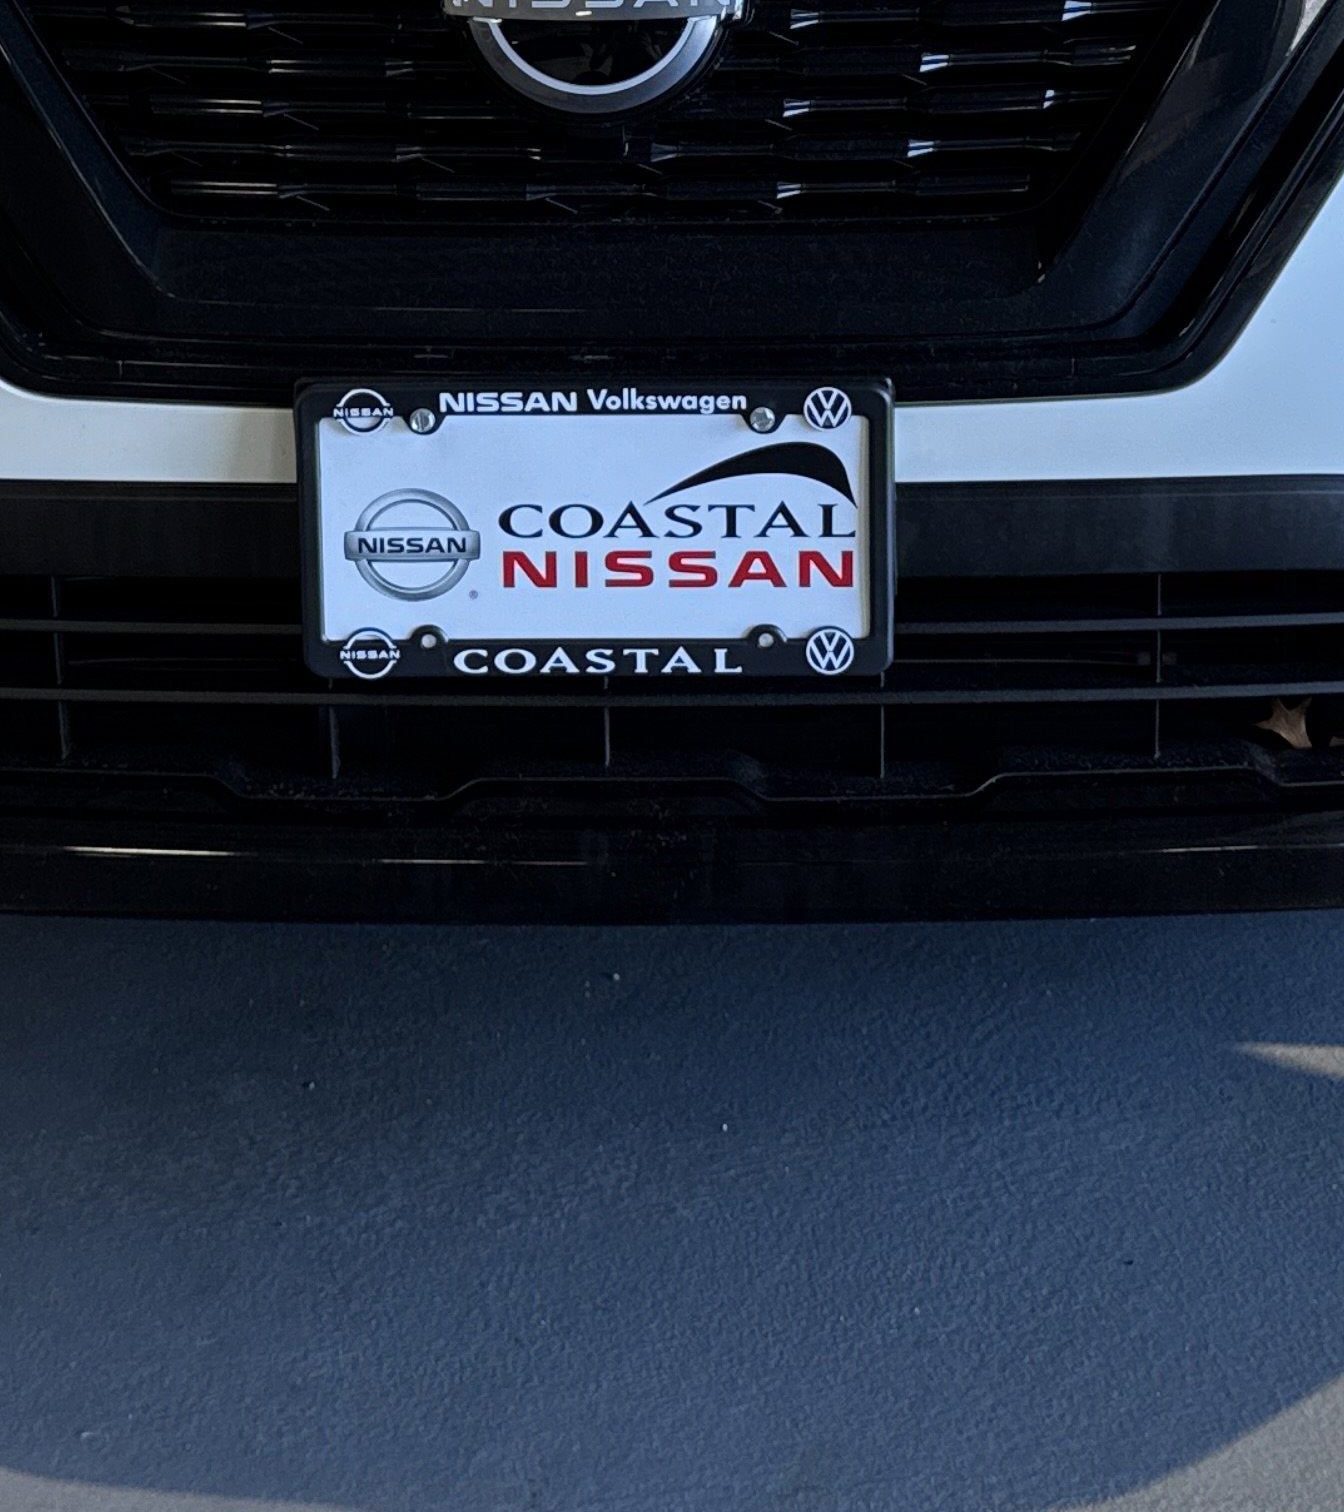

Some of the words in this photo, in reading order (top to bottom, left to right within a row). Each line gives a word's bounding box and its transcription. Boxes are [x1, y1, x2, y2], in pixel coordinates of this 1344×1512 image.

[333, 407, 394, 418] NISSAN
[439, 391, 578, 413] NISSAN
[587, 388, 748, 415] Volkswagen
[498, 500, 857, 540] COASTAL
[357, 536, 468, 555] NISSAN
[502, 550, 855, 589] NISSAN
[340, 649, 401, 661] NISSAN
[453, 647, 744, 675] COASTAL
